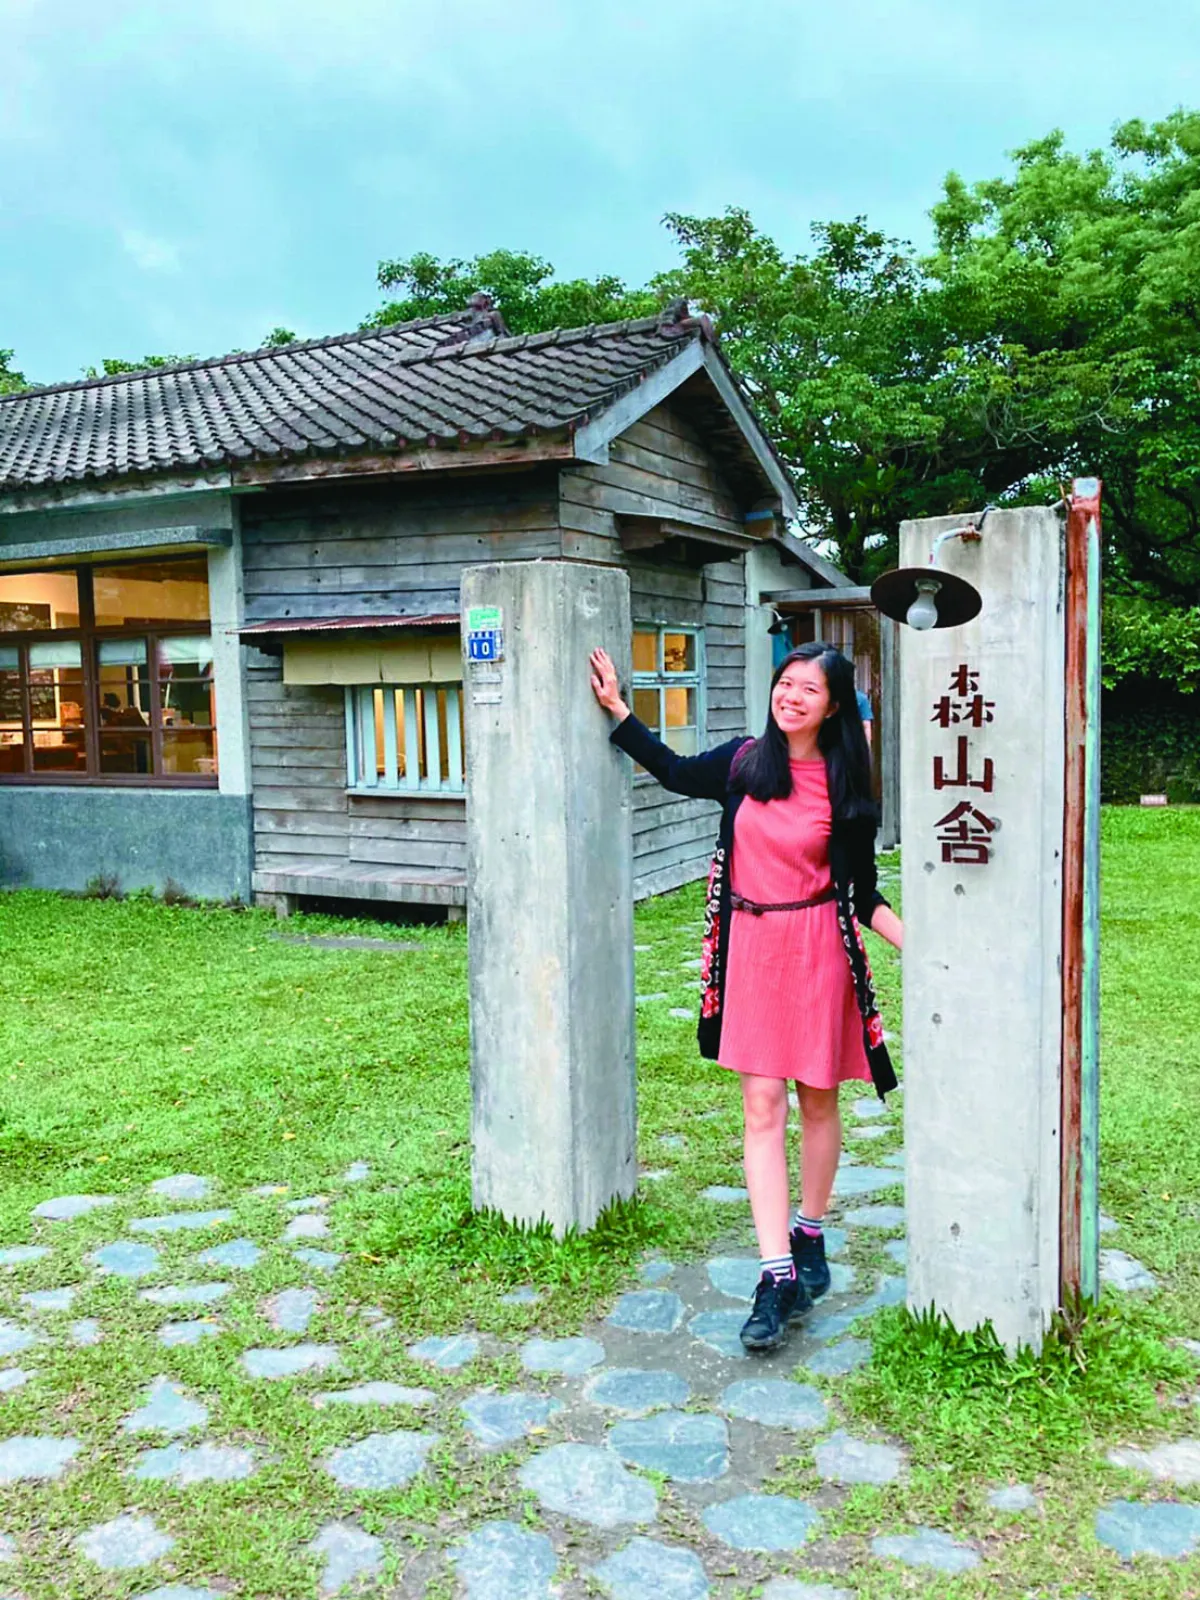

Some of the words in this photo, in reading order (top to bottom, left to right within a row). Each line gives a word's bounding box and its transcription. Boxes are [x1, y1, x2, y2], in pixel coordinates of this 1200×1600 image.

[472, 641, 489, 656] 10
[930, 664, 996, 864] 森山舍
